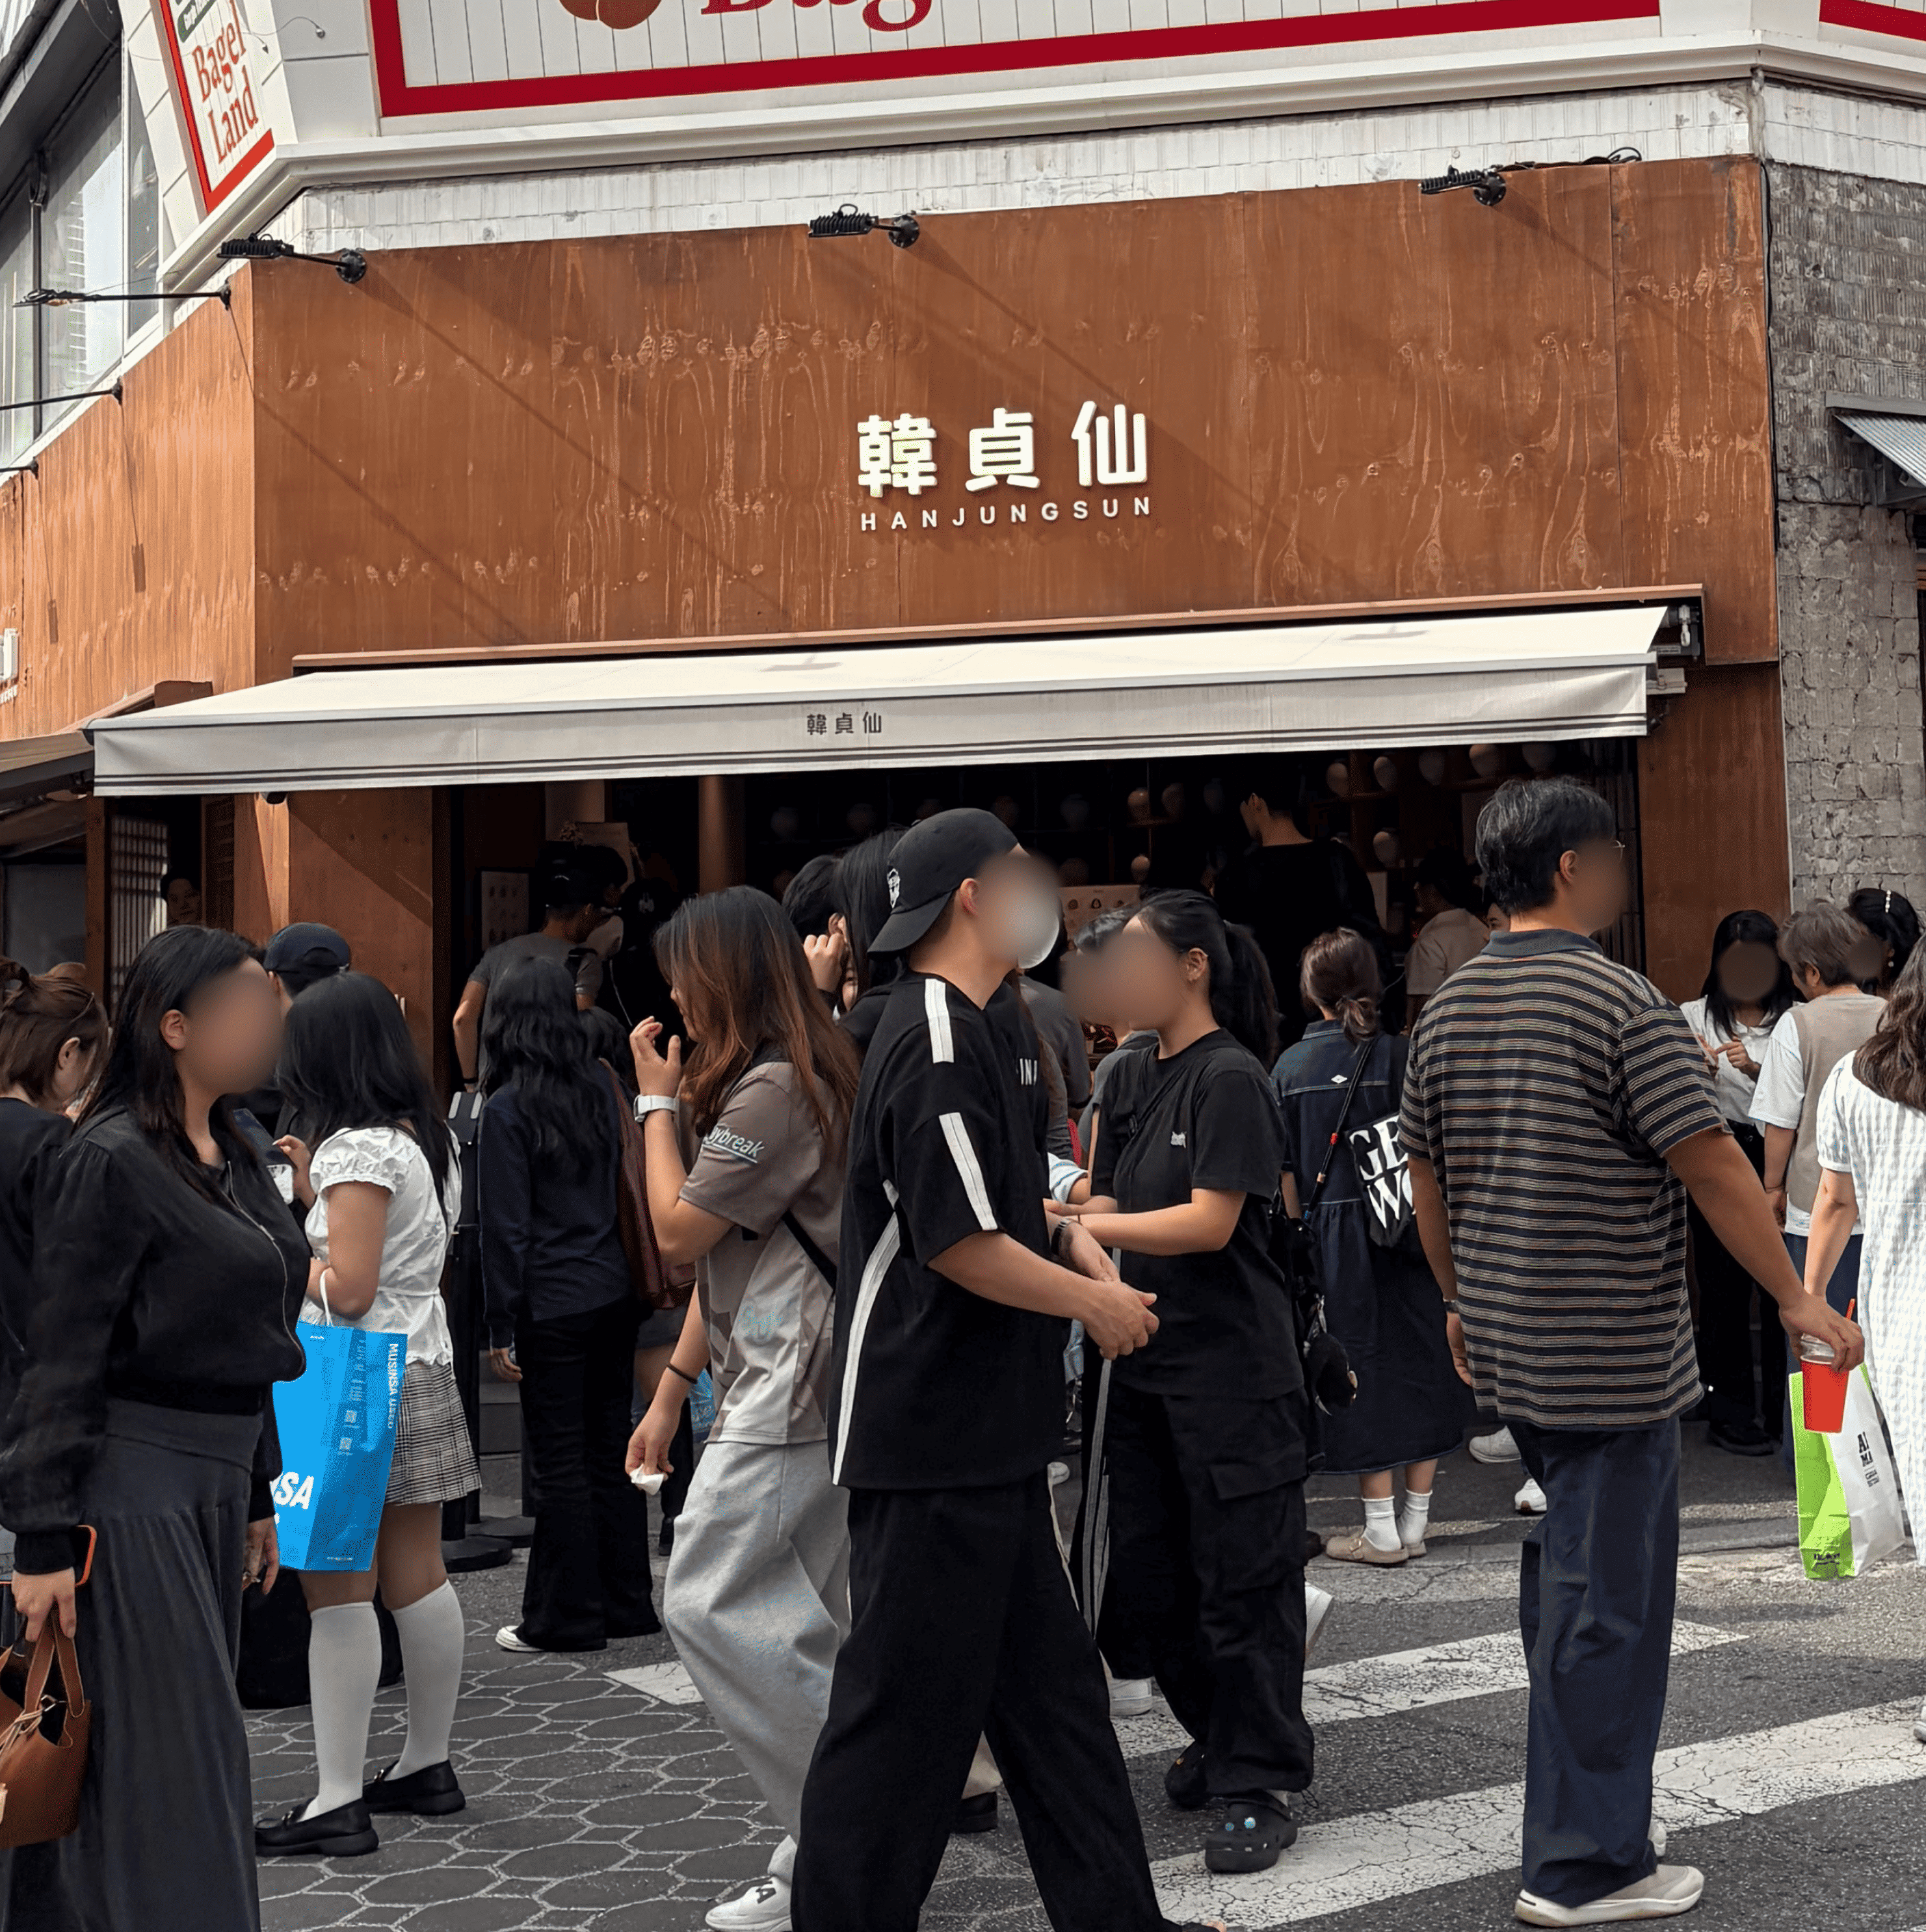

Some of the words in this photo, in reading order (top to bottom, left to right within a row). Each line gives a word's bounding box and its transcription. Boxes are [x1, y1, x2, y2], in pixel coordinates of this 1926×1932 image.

[192, 0, 246, 103] Bagel
[207, 64, 259, 164] Land
[858, 401, 1147, 497] 韓貞仙
[861, 496, 1150, 531] HANJUNGSUN
[806, 711, 882, 735] 韓貞仙
